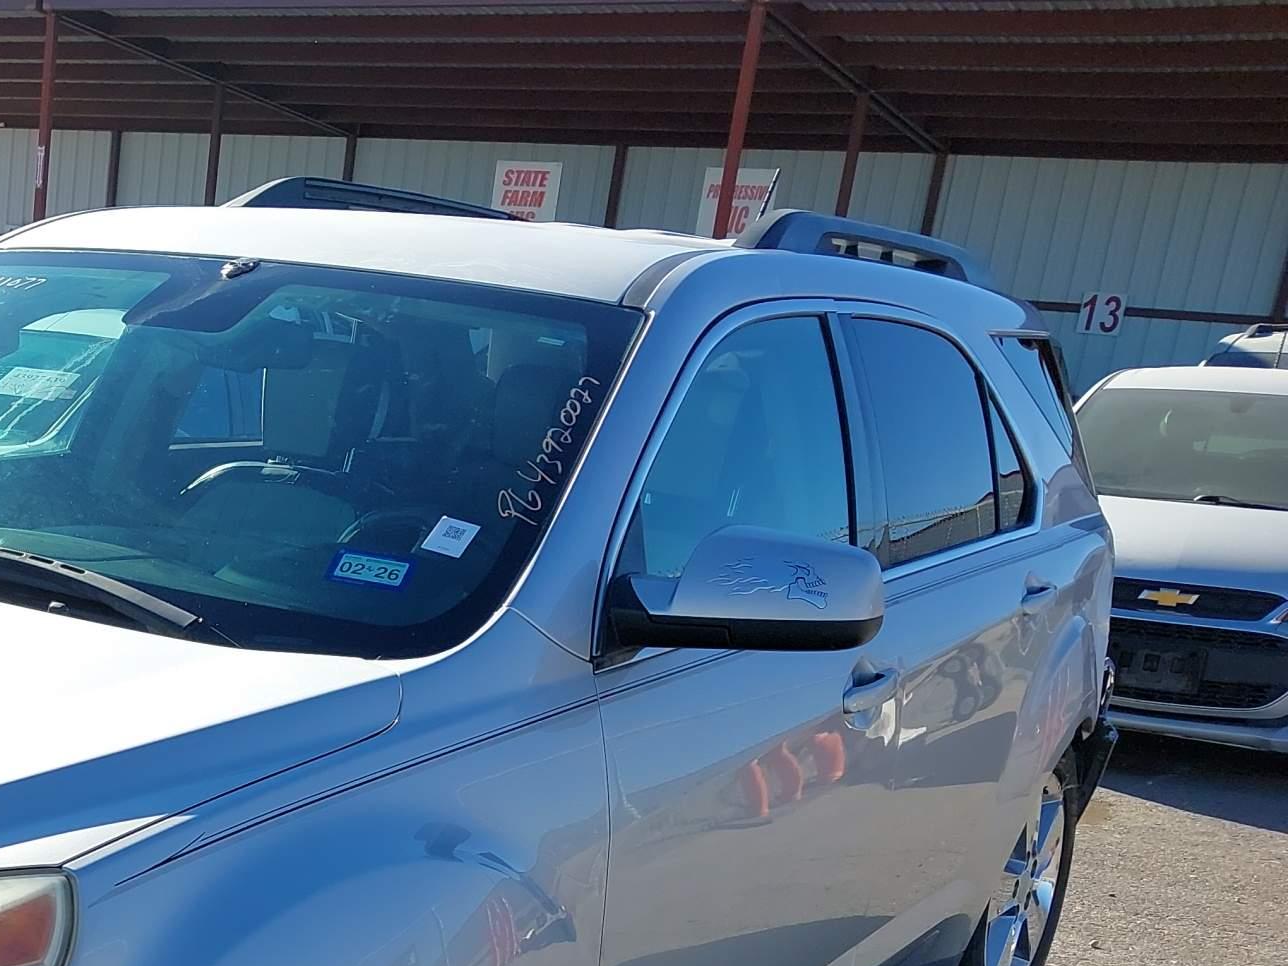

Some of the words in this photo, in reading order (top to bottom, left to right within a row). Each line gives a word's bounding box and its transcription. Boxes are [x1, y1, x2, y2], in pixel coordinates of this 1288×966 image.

[502, 169, 552, 188] STATE
[500, 190, 546, 209] FARM
[1083, 294, 1122, 333] 13
[340, 561, 366, 575] 02
[374, 566, 402, 581] 26
